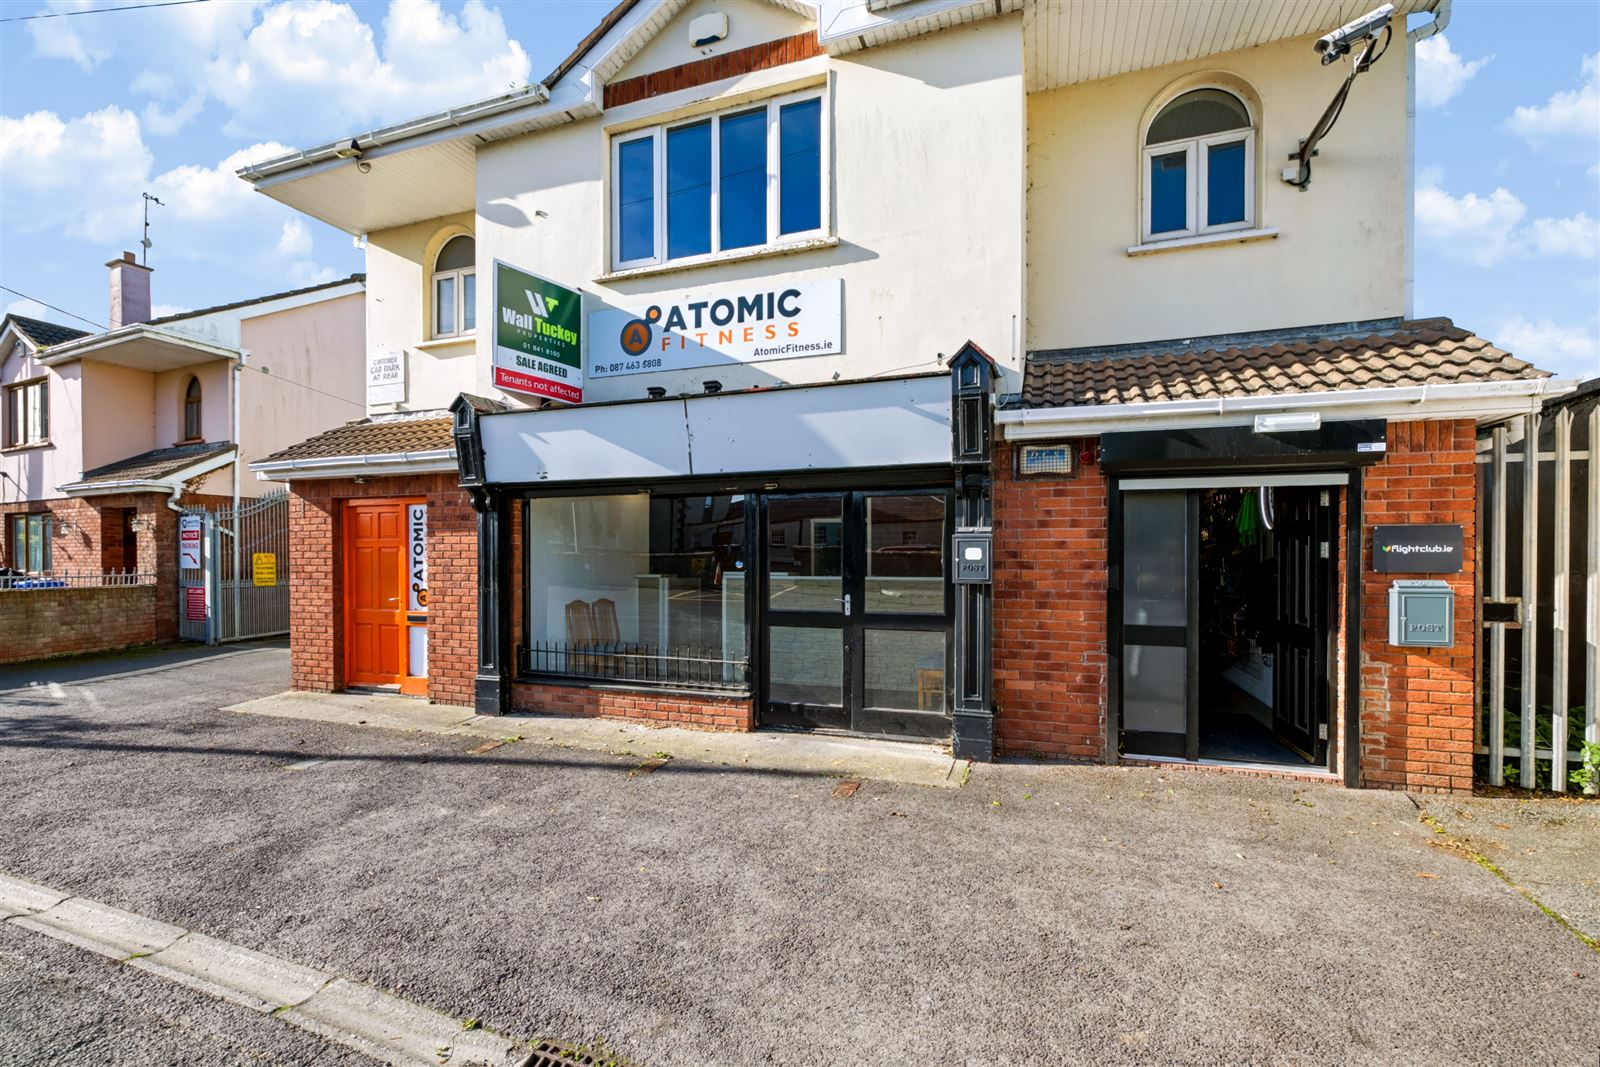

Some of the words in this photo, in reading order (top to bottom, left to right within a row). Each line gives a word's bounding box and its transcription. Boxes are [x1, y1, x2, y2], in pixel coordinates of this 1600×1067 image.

[663, 288, 802, 333] ATOMIC
[502, 306, 533, 330] Wall
[535, 317, 577, 346] Tuckey
[516, 329, 566, 348] PROPERTIES
[661, 321, 800, 352] FITNESS
[522, 342, 531, 350] 01
[545, 348, 561, 358] 8100
[753, 340, 833, 357] AtomicFitness.ie
[383, 364, 401, 372] PARK
[516, 355, 537, 370] SALE
[537, 361, 568, 379] AGREED
[595, 364, 608, 373] Ph:
[609, 362, 624, 372] 087
[625, 360, 641, 370] 463
[642, 358, 662, 369] 5808
[383, 372, 398, 380] REAR
[500, 372, 532, 387] Tenants
[533, 381, 548, 391] not
[549, 385, 580, 399] affected
[413, 508, 424, 581] ATOMIC
[1391, 545, 1454, 554] flightclub.ie
[961, 564, 985, 572] POST
[1409, 623, 1444, 633] POST
